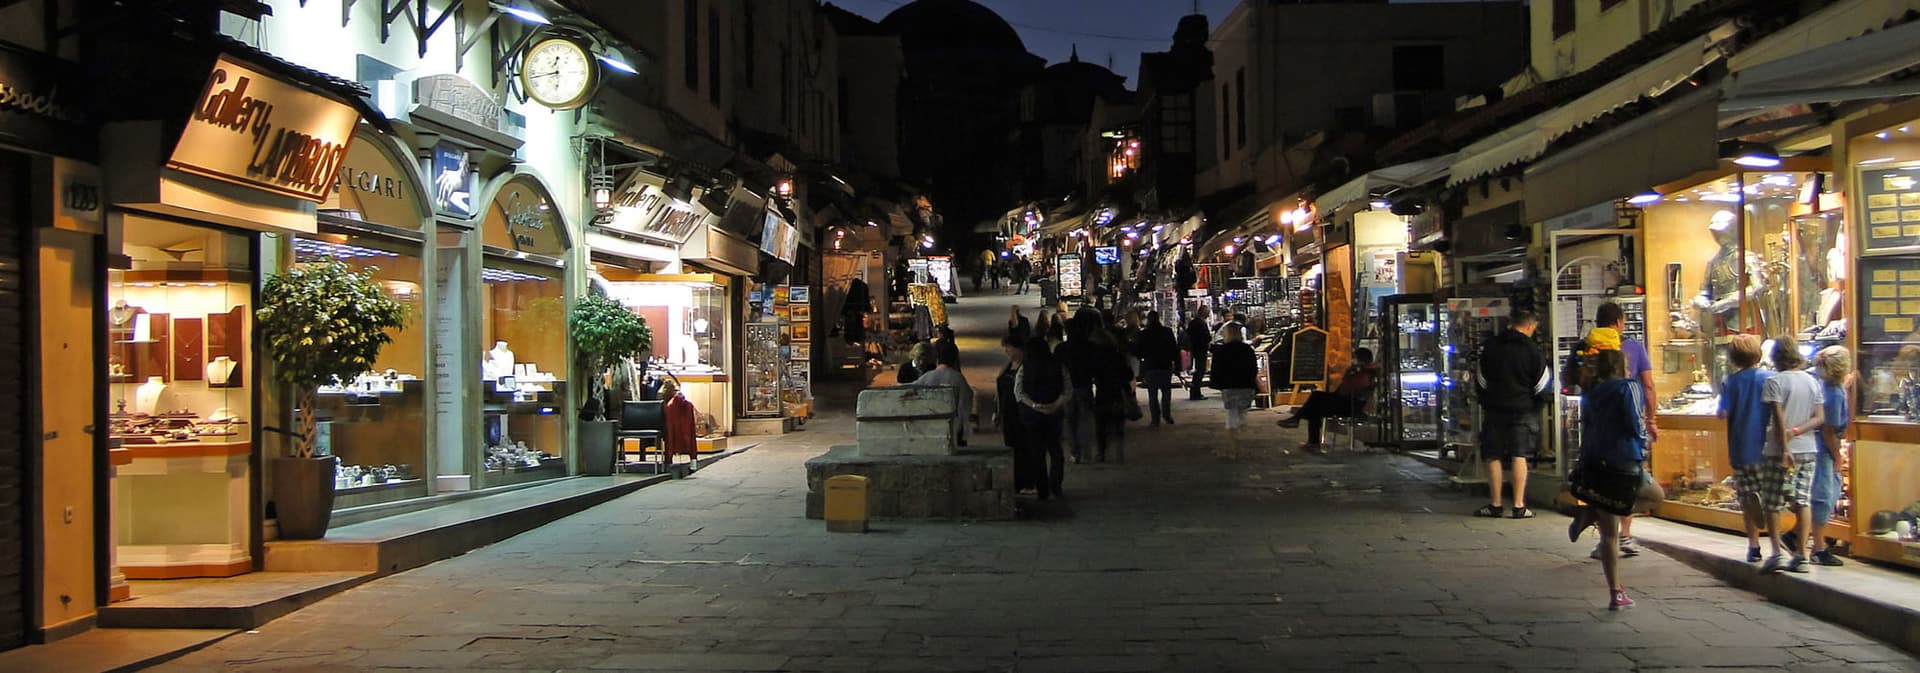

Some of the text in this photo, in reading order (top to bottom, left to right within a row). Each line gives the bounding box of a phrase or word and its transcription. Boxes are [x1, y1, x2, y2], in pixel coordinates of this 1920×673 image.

[195, 68, 273, 144] Gallery
[246, 122, 344, 193] LAMBROS
[334, 166, 403, 200] VLGARI
